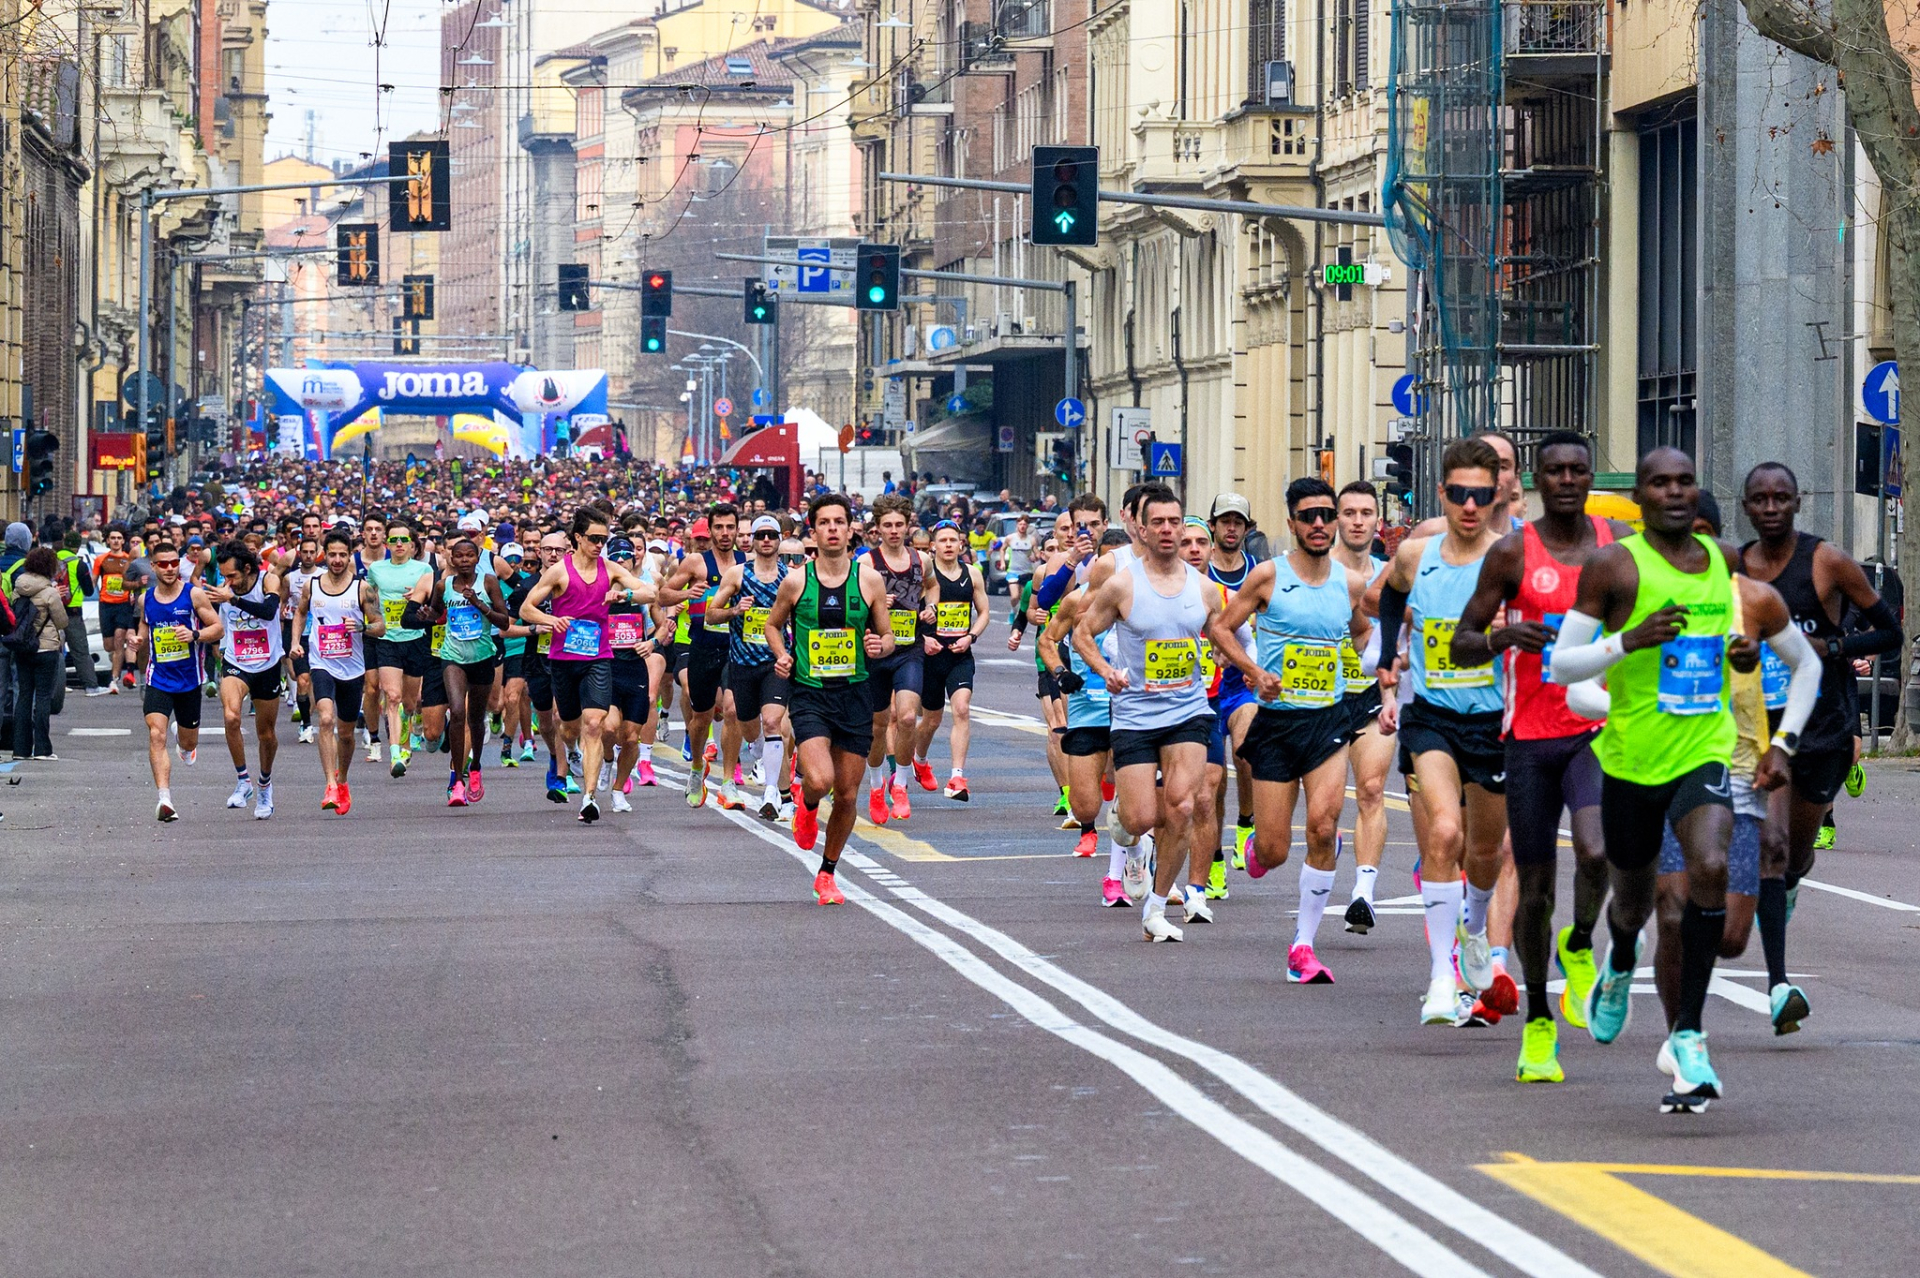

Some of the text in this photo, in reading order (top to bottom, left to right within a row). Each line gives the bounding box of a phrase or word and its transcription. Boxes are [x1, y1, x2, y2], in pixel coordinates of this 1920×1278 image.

[1326, 265, 1365, 283] 09:01
[615, 632, 637, 640] 5053
[161, 645, 183, 653] 9622
[241, 647, 264, 655] 4796
[818, 655, 849, 665] 8480
[1155, 667, 1187, 679] 9285
[1292, 677, 1328, 691] 5502
